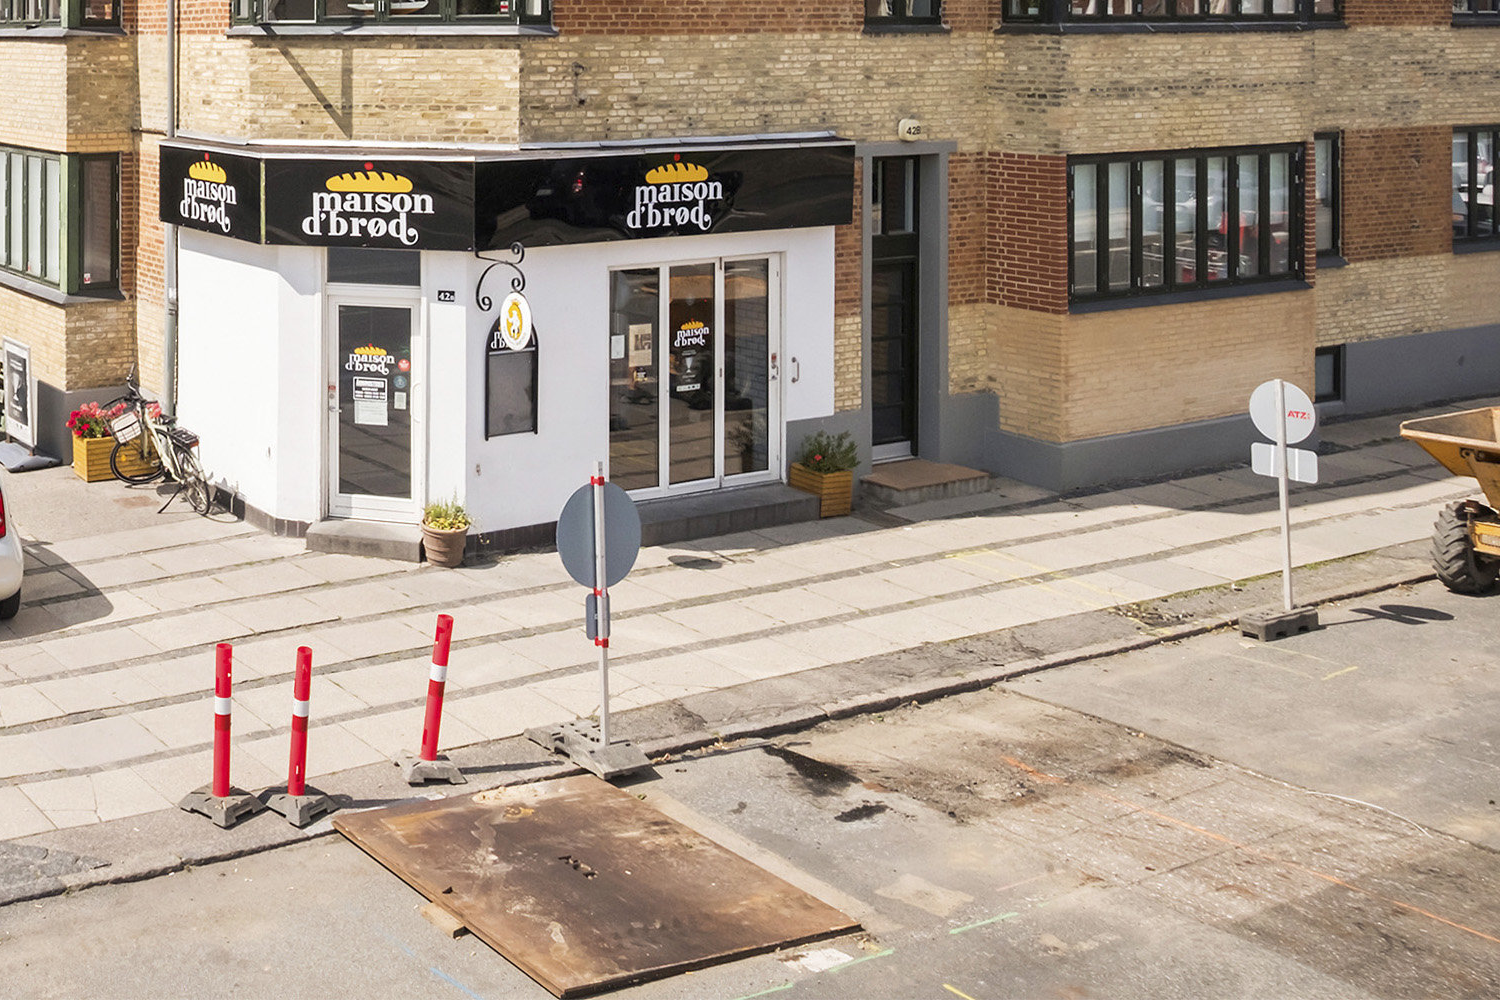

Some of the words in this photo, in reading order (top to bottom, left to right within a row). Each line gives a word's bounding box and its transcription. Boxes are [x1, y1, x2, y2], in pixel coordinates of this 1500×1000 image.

[184, 178, 237, 205] maison
[635, 181, 723, 205] maison
[312, 192, 435, 214] maison
[677, 327, 710, 338] maison
[349, 353, 395, 364] maison
